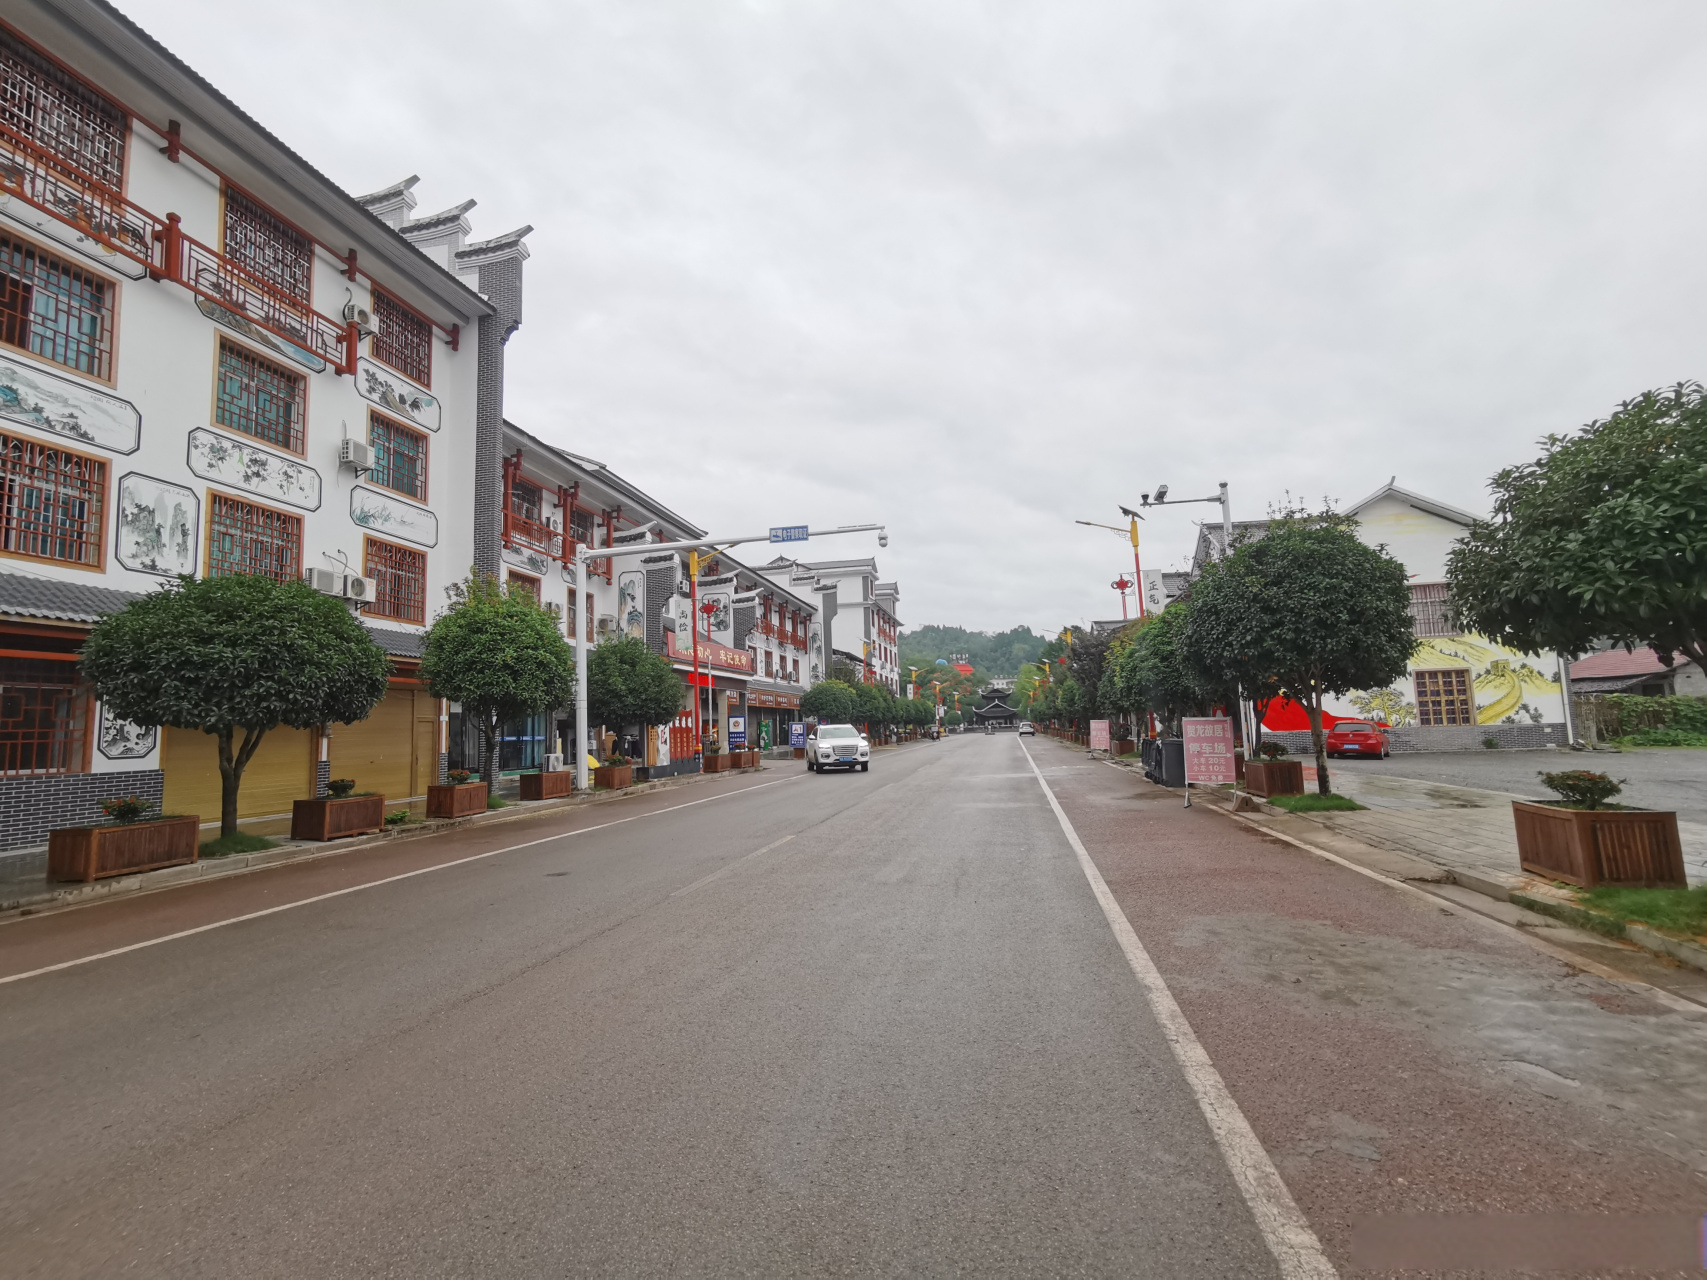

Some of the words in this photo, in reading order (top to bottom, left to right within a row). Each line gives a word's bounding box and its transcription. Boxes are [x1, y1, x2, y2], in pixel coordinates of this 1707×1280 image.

[1148, 580, 1159, 605] 正气
[679, 609, 688, 632] 尚俭
[719, 649, 747, 666] 牢记使命
[1187, 724, 1223, 738] 贺龙故居
[1188, 742, 1226, 754] 停车场
